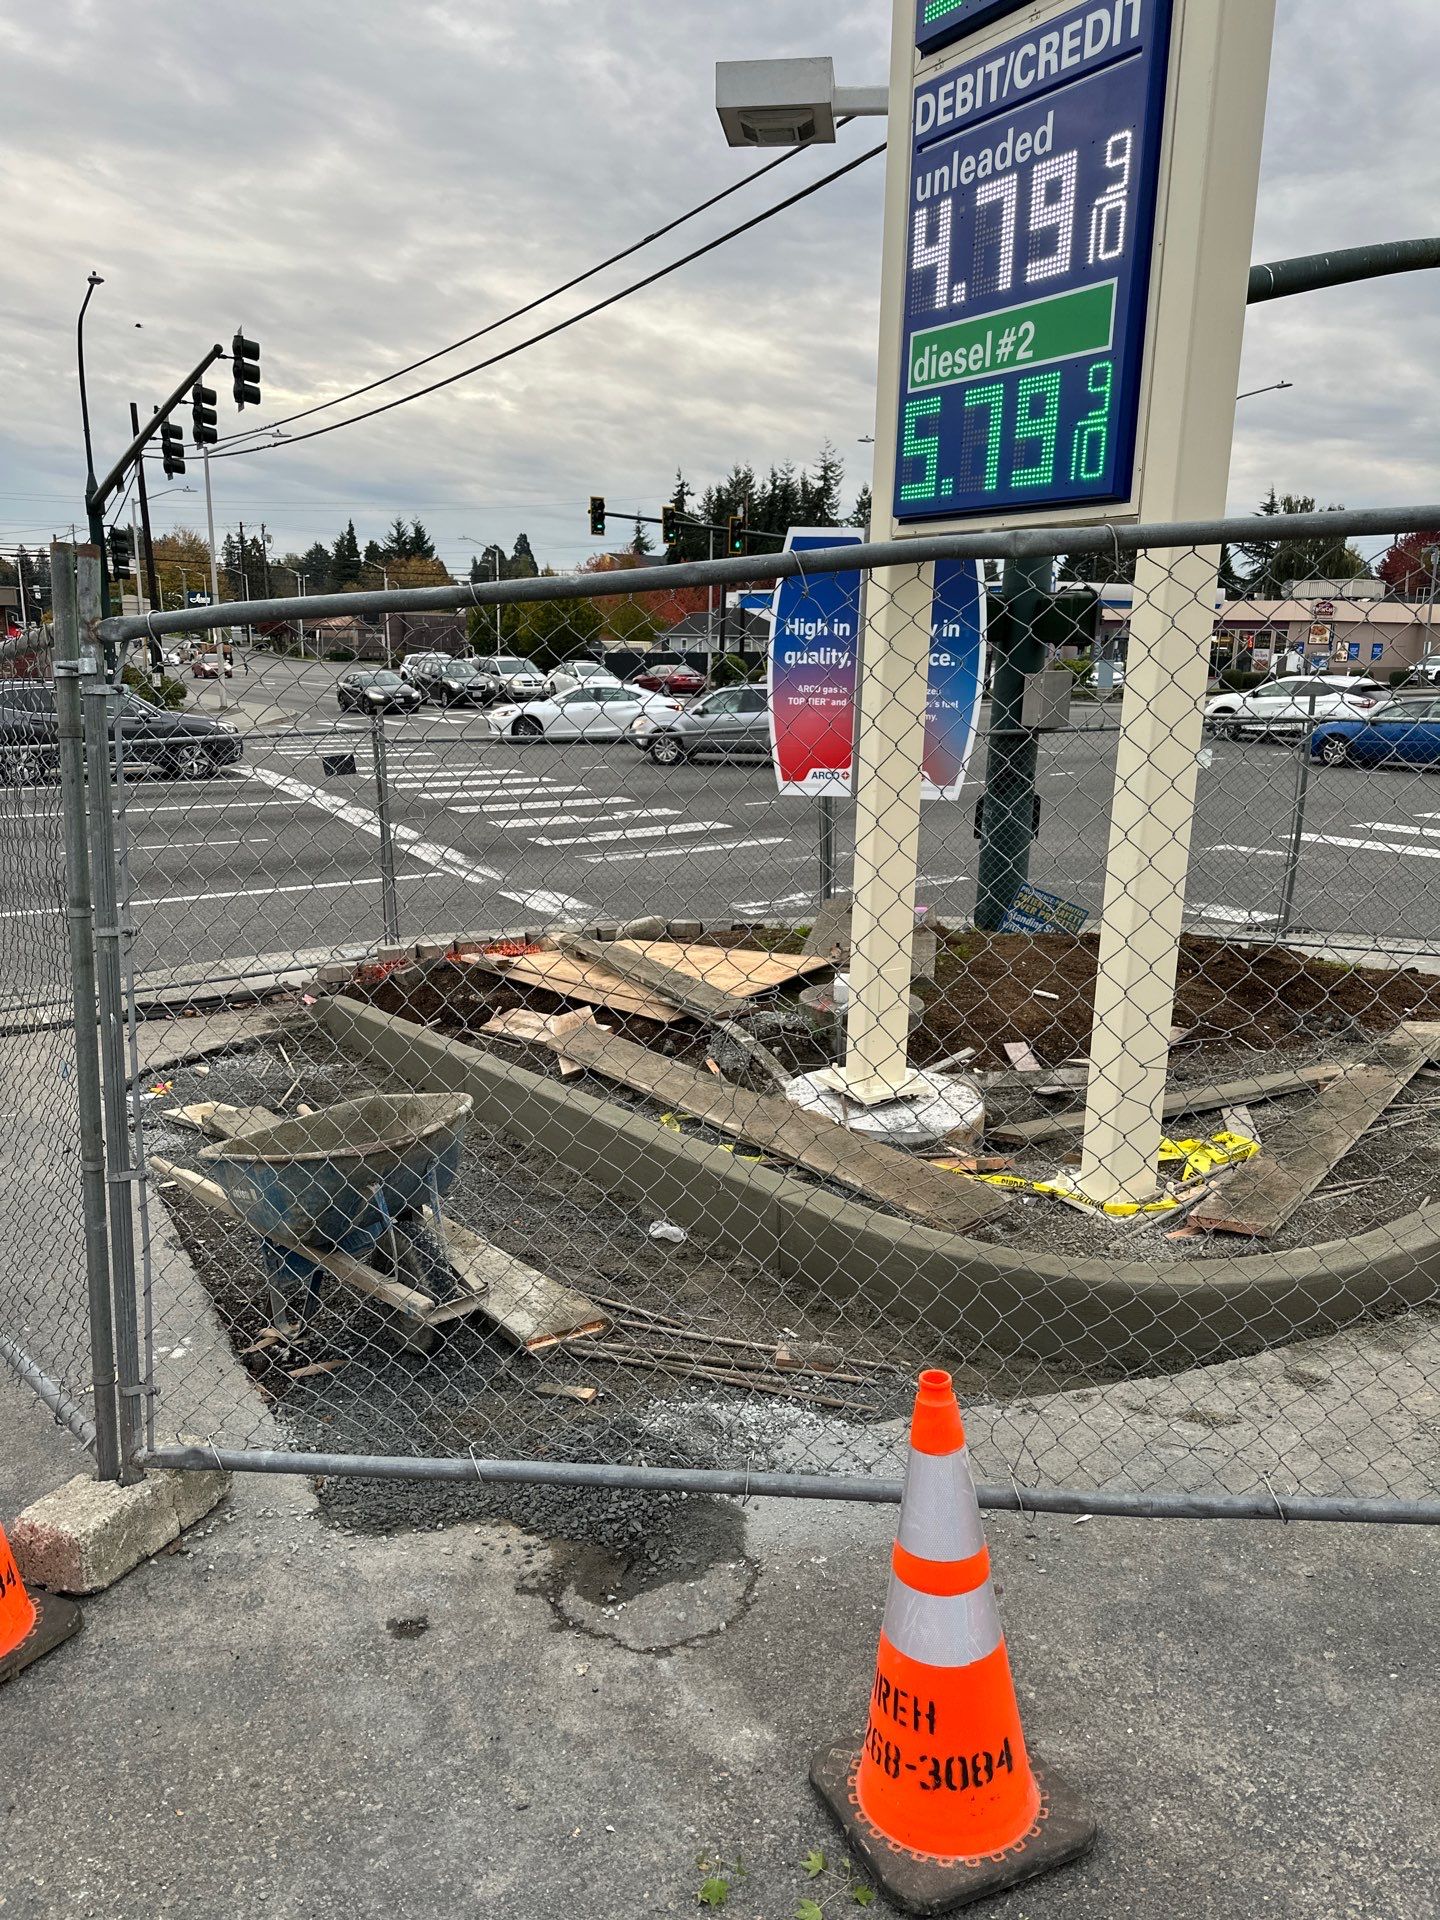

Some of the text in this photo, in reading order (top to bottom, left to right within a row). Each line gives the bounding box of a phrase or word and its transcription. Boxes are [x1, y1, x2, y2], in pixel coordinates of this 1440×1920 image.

[914, 0, 1142, 136] DEBIT/CREDIT
[915, 110, 1055, 202] unleaded
[912, 149, 1078, 309] 4.79
[913, 320, 1036, 383] diesel #2
[900, 370, 1061, 501] 5.79
[785, 618, 850, 640] High in
[942, 619, 960, 637] in
[784, 647, 852, 669] quality,
[788, 697, 806, 705] TOP
[822, 687, 838, 695] gas
[811, 771, 840, 780] ARCO
